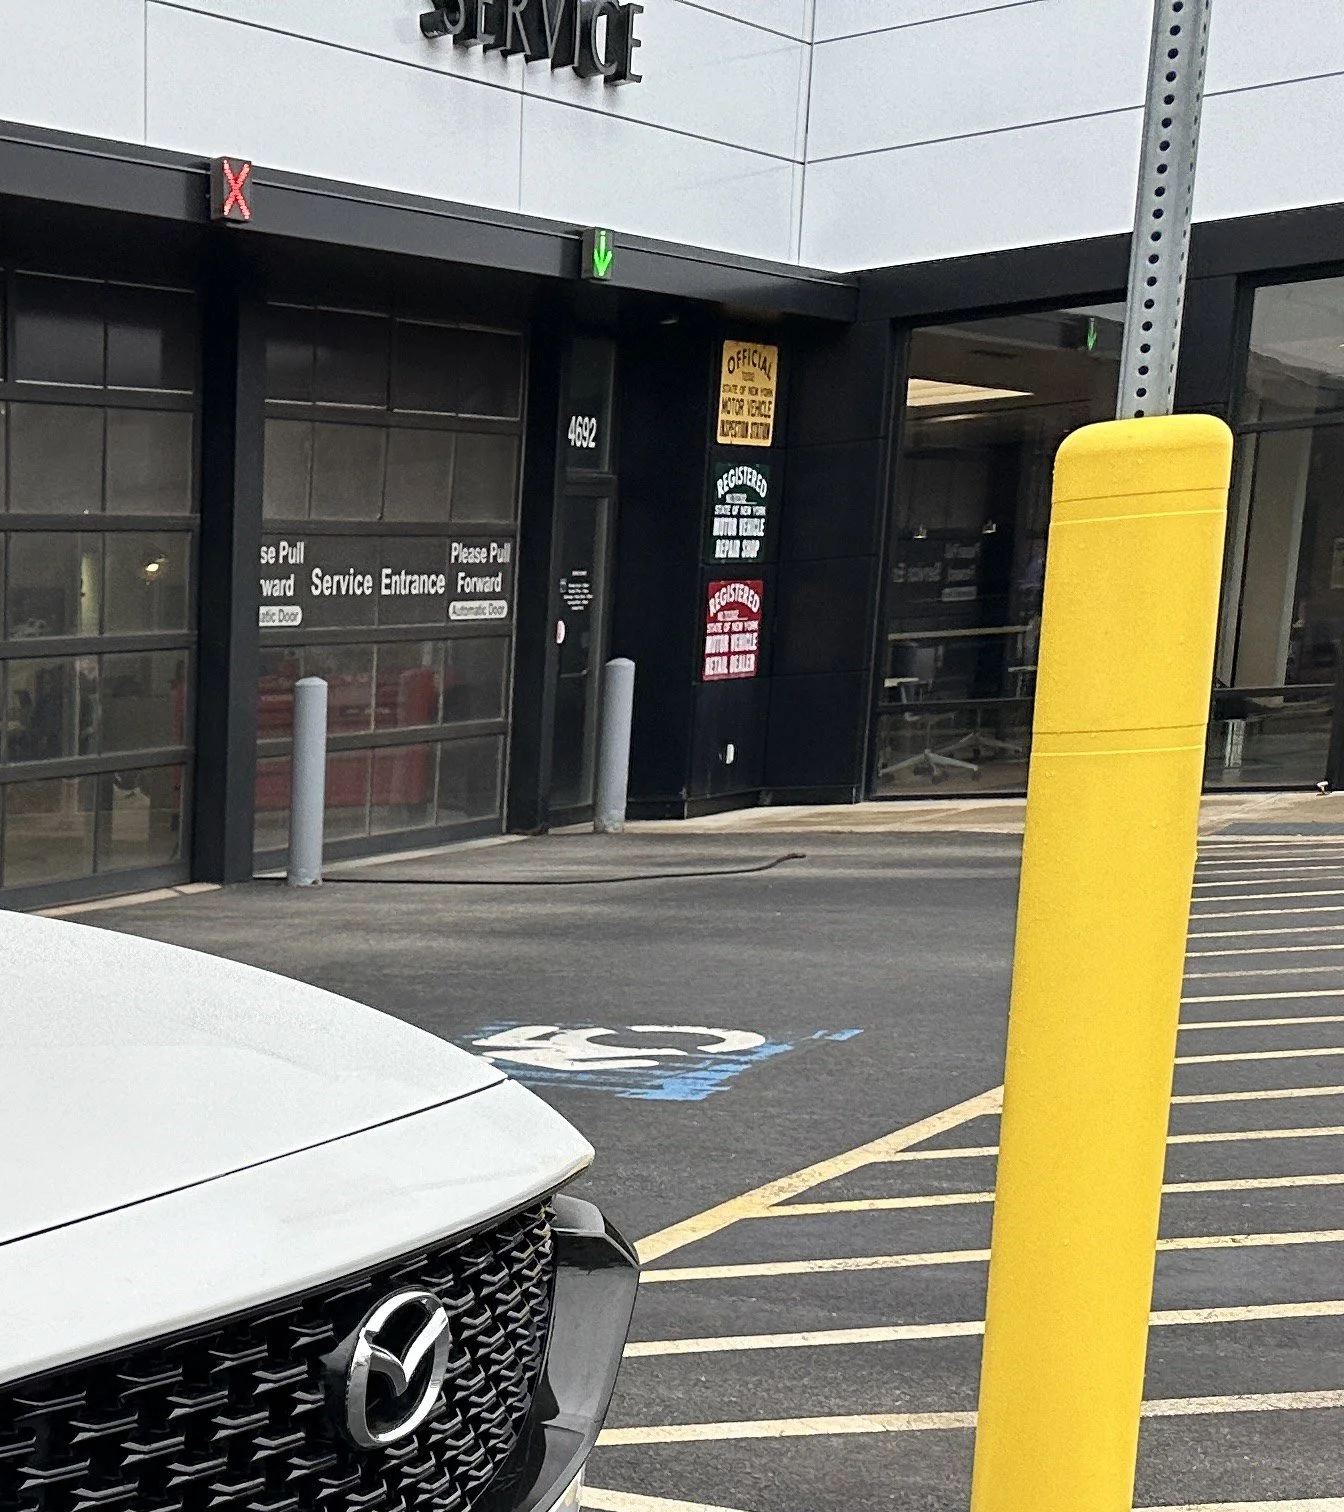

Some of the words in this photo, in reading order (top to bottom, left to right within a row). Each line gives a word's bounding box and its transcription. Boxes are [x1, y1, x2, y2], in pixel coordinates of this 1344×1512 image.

[419, 0, 644, 86] SERVICE
[727, 348, 772, 381] OFFICIAL
[721, 397, 745, 416] MOTOR
[747, 399, 772, 419] VEHICLE
[568, 415, 597, 448] 4692
[717, 466, 768, 499] REGISTERED
[279, 541, 305, 564] Pull
[451, 542, 487, 564] Please
[489, 542, 511, 564] Pull
[260, 573, 295, 597] ward
[311, 567, 373, 596] Service
[381, 568, 446, 595] Entrance
[457, 571, 502, 594] Forward
[488, 603, 506, 617] Door
[709, 583, 760, 617] REGISTERED
[278, 608, 300, 623] Door
